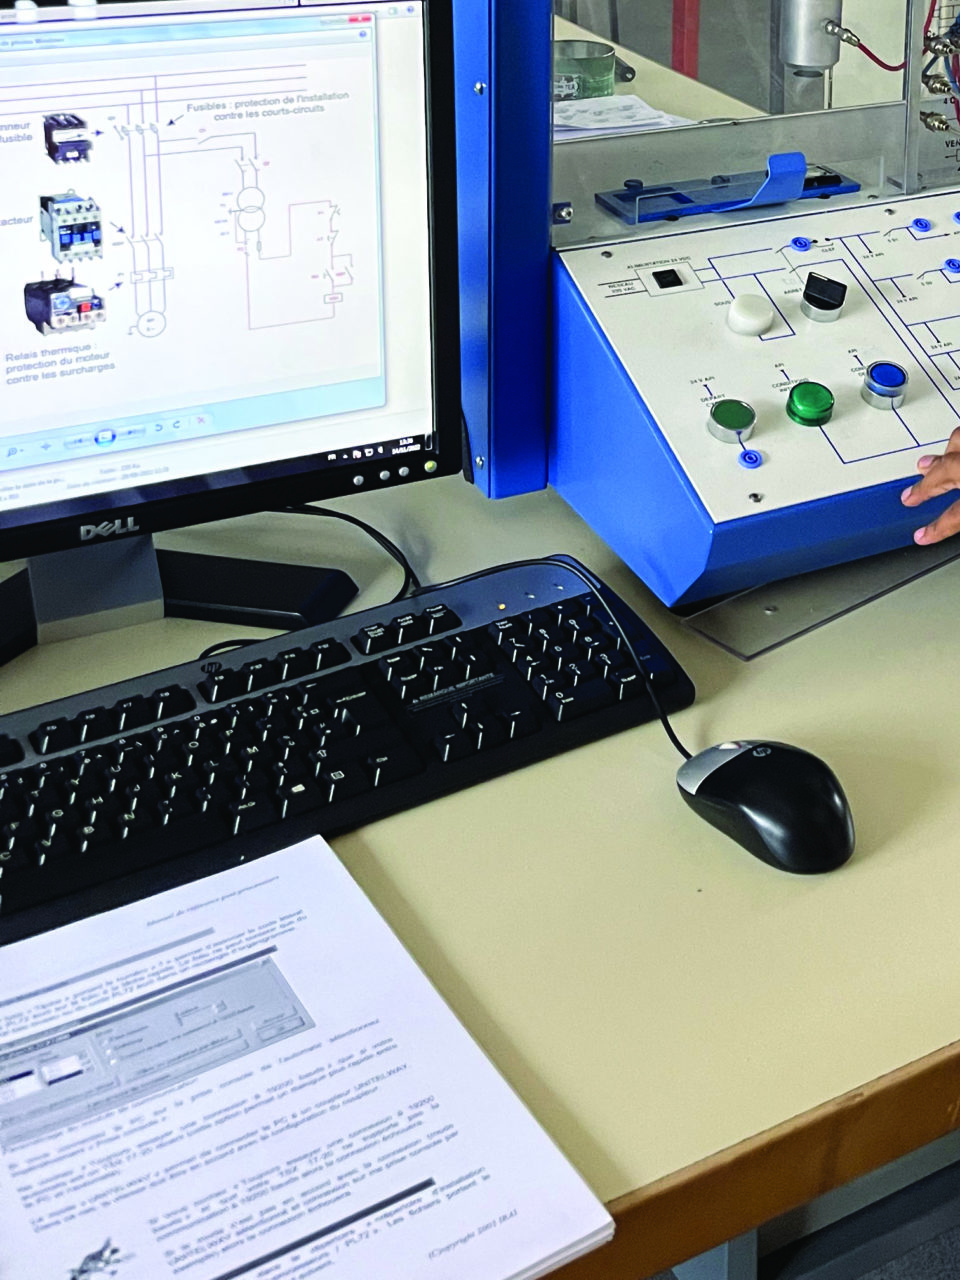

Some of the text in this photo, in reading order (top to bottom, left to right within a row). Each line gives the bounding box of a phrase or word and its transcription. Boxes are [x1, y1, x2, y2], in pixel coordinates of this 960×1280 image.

[186, 102, 227, 112] Fusibles
[234, 97, 281, 110] protection
[282, 95, 295, 105] de
[214, 104, 326, 121] contre les courts-circuits
[5, 350, 38, 362] Relais
[40, 344, 92, 358] thermique
[6, 351, 110, 375] protection du moteur
[6, 362, 116, 385] contre les surcharges
[80, 516, 140, 541] DELL
